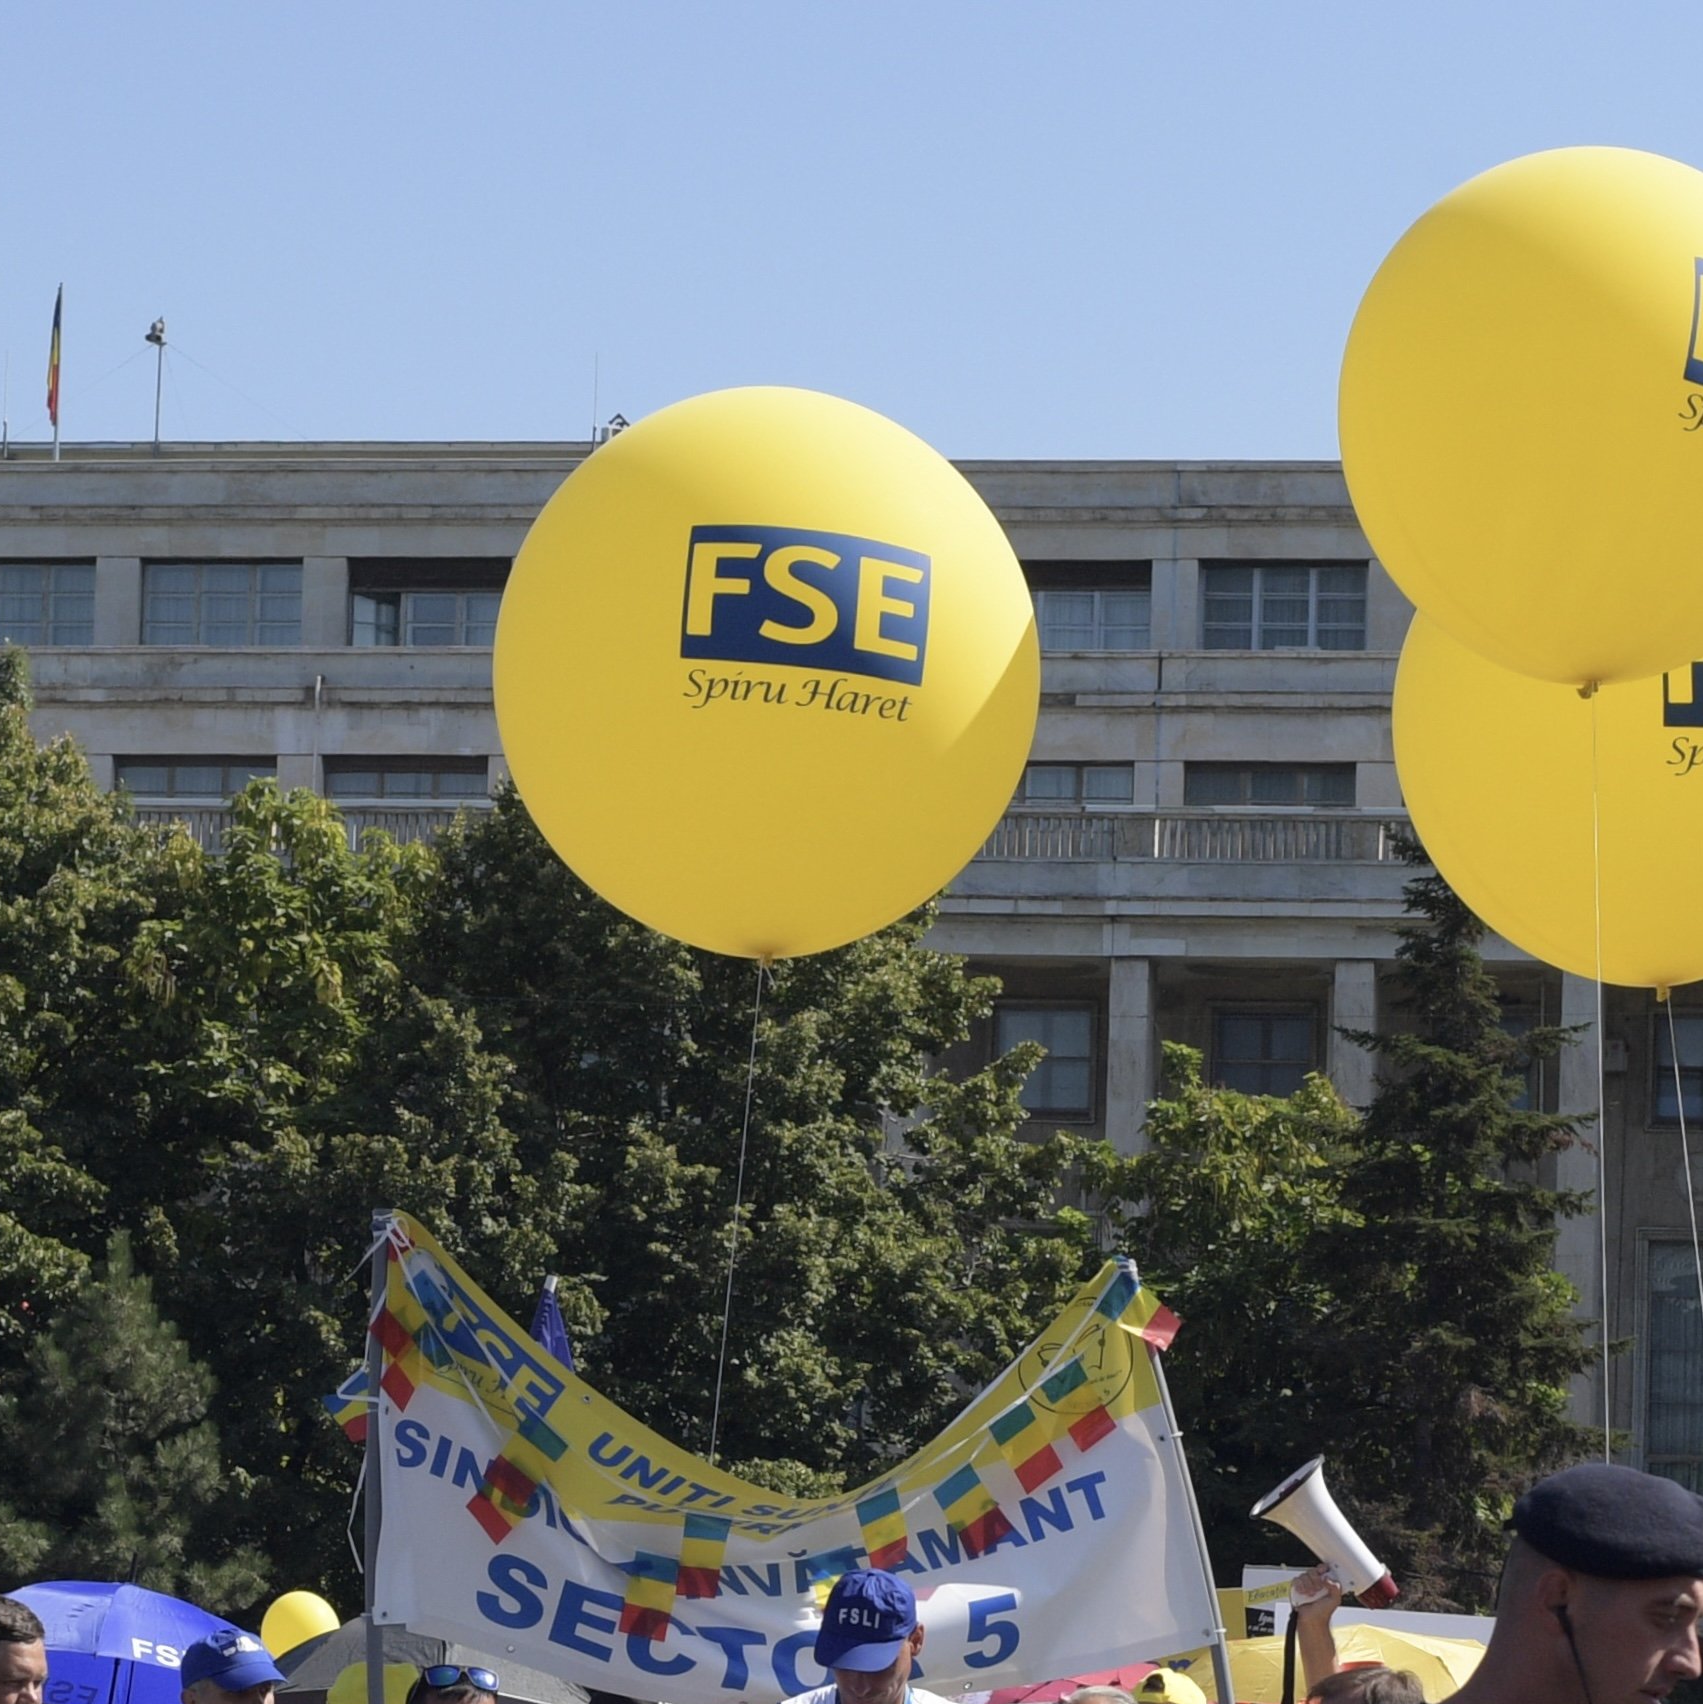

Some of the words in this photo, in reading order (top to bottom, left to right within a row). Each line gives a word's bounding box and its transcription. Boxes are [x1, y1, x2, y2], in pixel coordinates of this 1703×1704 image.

[685, 541, 925, 662] FSE
[682, 668, 789, 710] Spiru
[794, 677, 914, 723] Haret
[475, 1552, 925, 1698] SECTO
[963, 1592, 1021, 1669] 5
[837, 1607, 881, 1630] FSLI
[131, 1637, 185, 1667] FS
